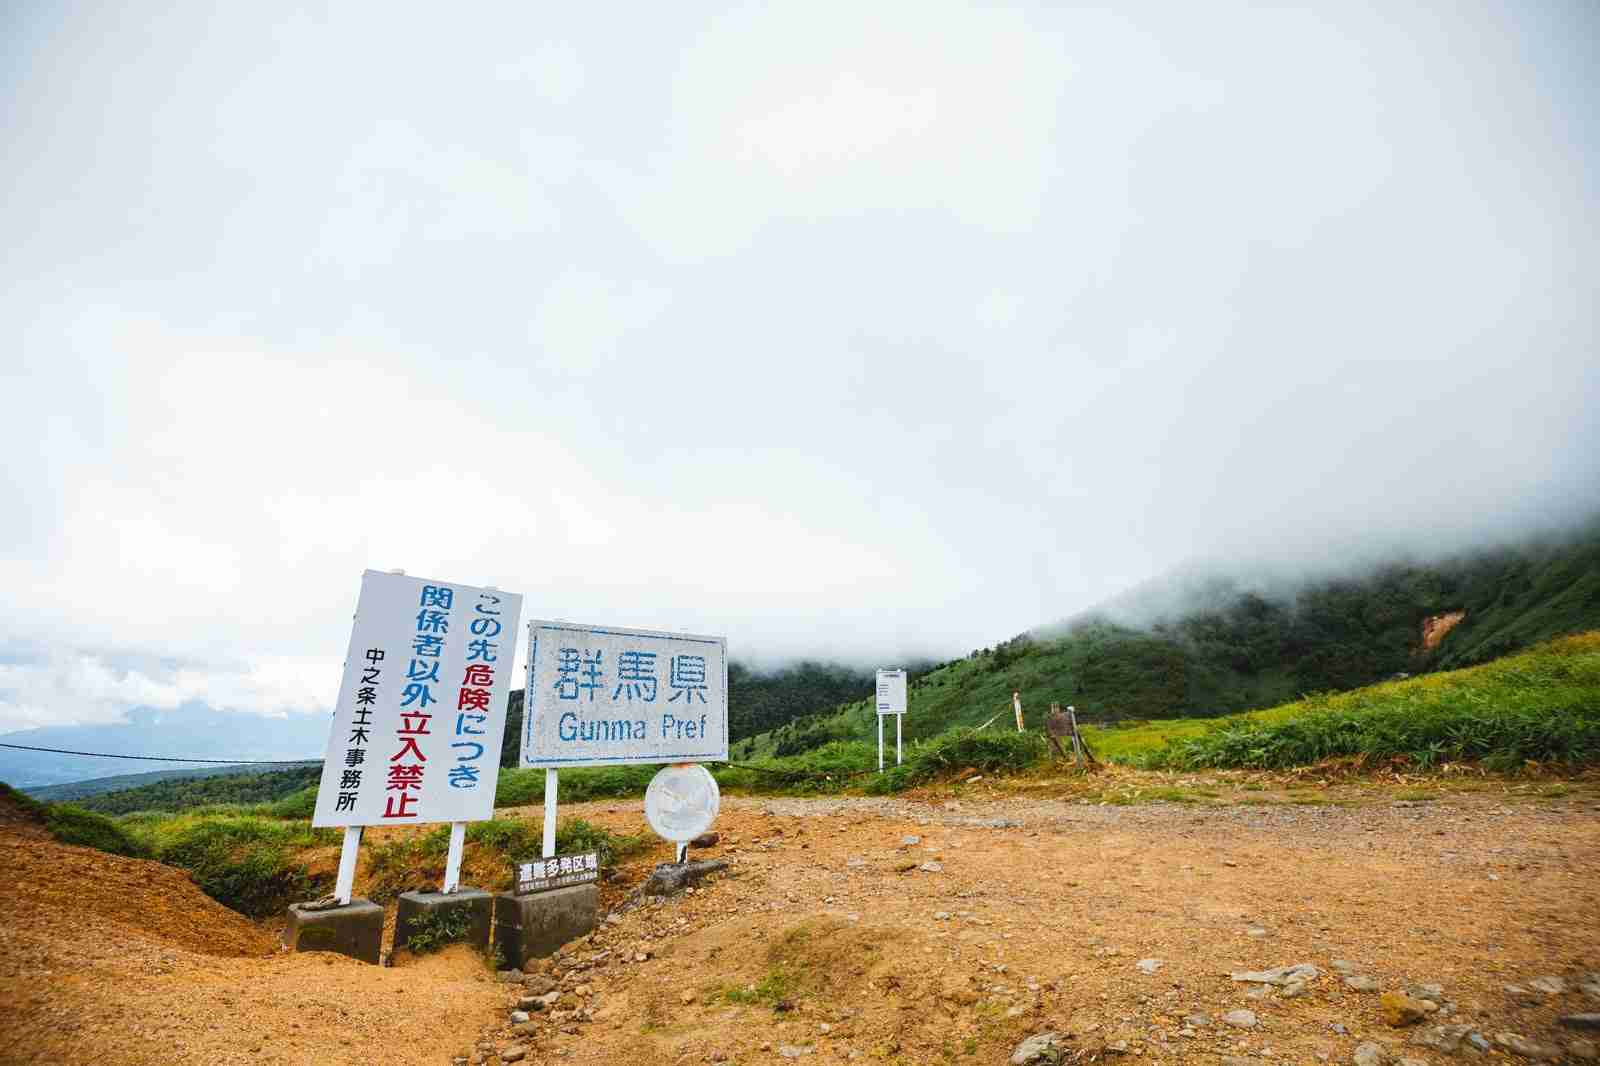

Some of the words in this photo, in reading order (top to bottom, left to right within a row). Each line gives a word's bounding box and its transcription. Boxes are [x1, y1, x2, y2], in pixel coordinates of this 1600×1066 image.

[336, 648, 385, 812] 中之条土木事務所
[383, 585, 452, 819] 関係者以外立入禁止
[448, 592, 502, 789] この先危険につき
[552, 647, 708, 705] 群馬県
[558, 711, 645, 742] Gunma
[661, 714, 707, 740] Pref
